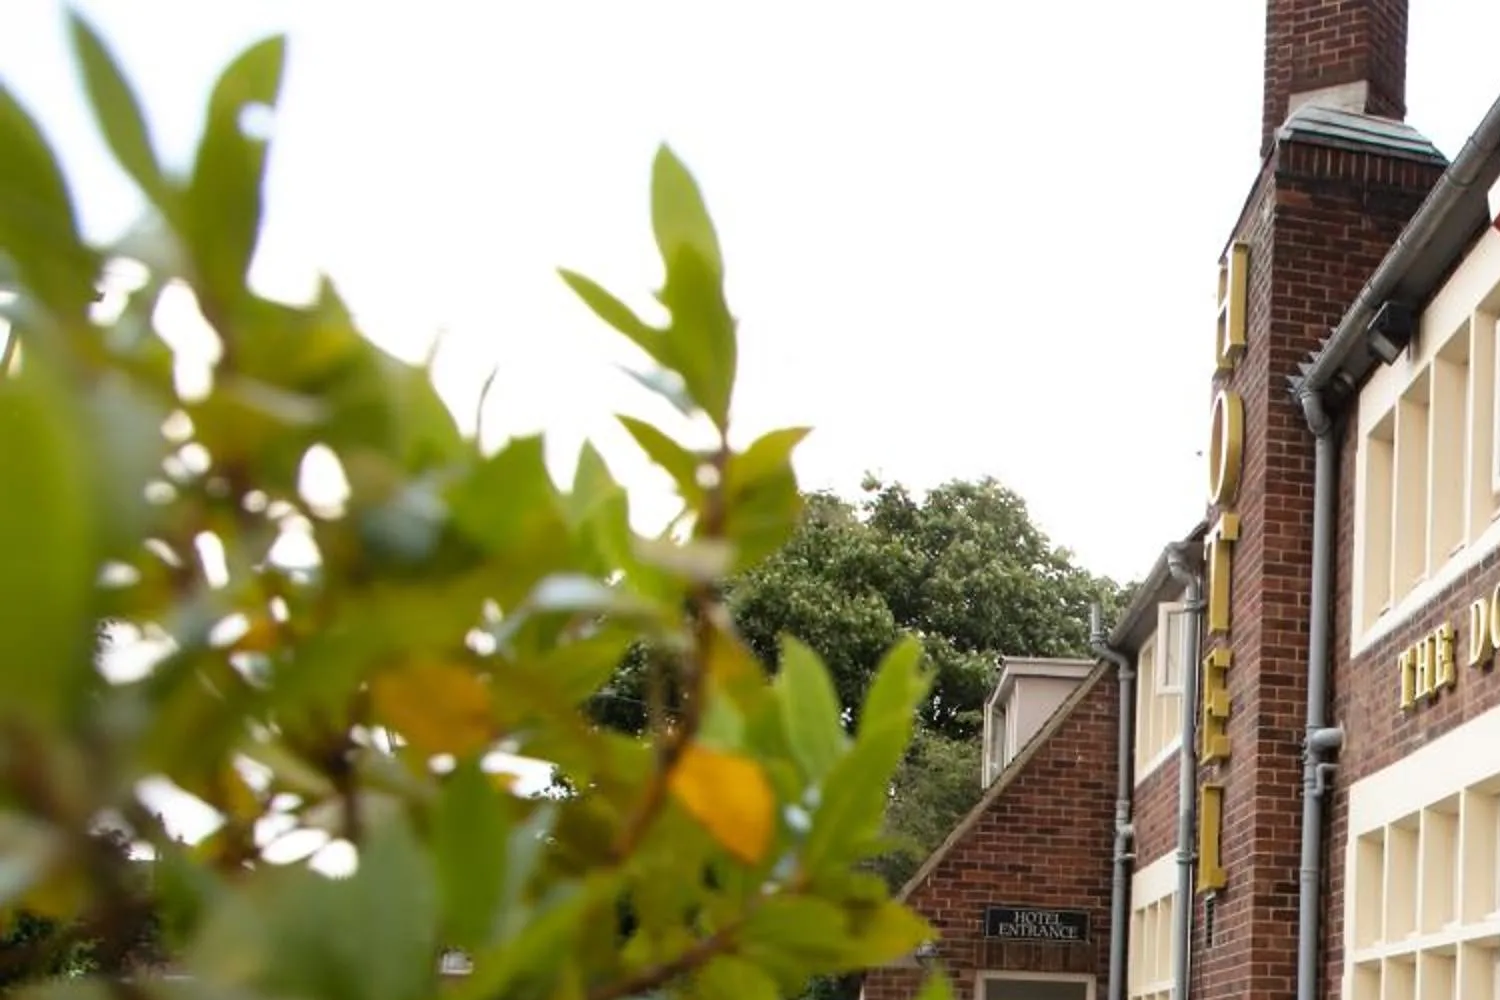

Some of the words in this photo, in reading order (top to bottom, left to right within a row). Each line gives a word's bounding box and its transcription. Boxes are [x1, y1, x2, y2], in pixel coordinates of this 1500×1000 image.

[1198, 239, 1248, 897] HOTEL
[1399, 620, 1457, 711] THE
[999, 922, 1078, 939] ENTRANCE
[1015, 911, 1060, 925] HOTEL
